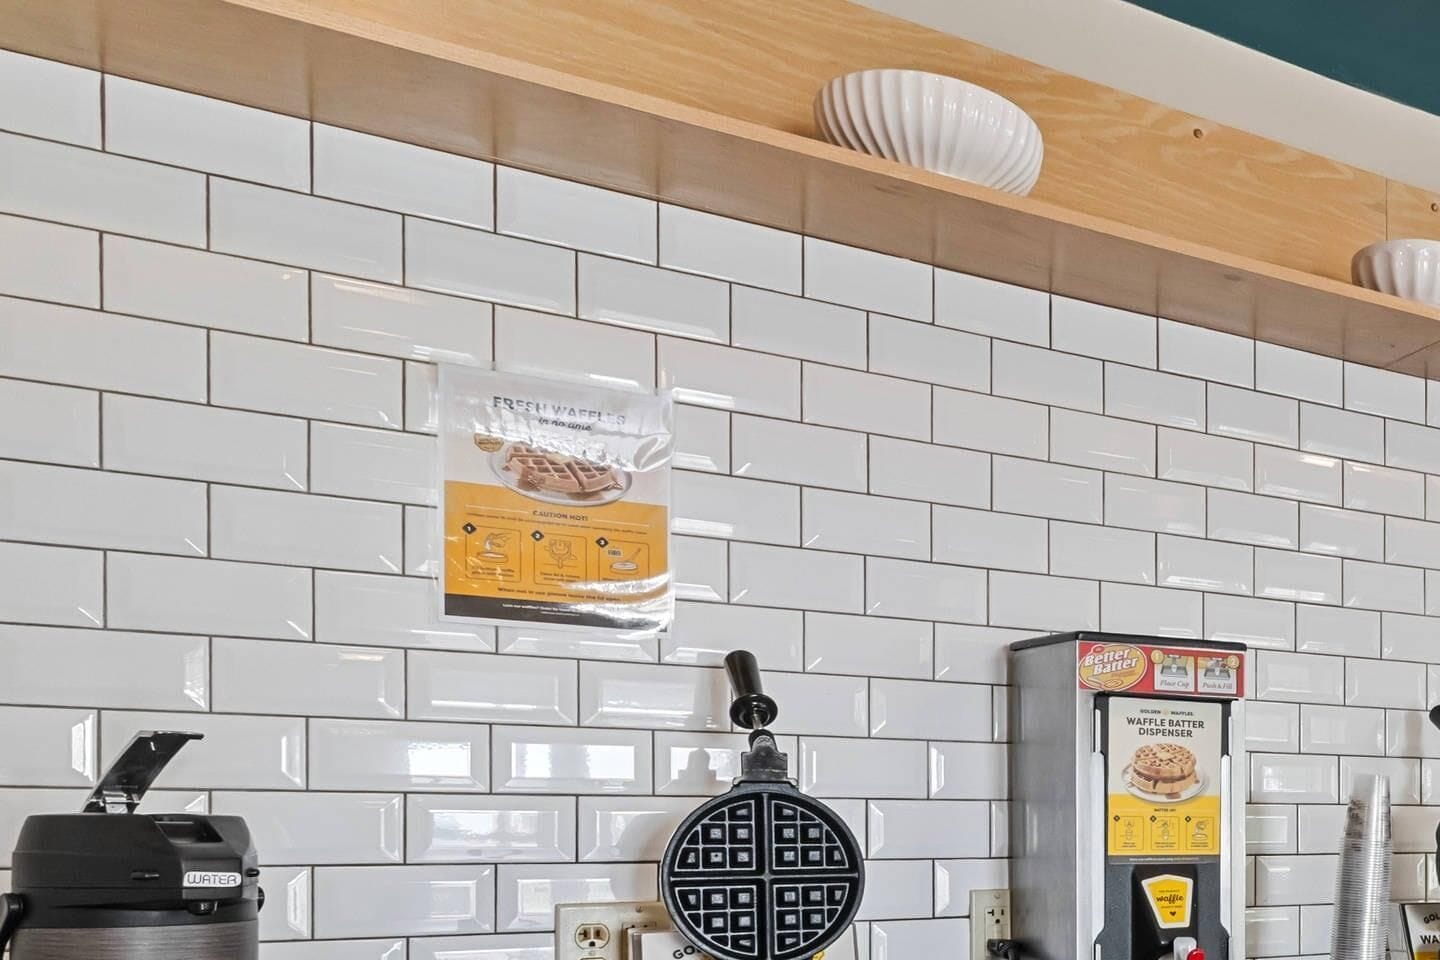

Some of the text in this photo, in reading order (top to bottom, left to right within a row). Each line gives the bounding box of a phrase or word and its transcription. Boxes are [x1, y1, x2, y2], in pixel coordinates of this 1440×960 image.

[493, 396, 625, 425] FRESH WAFFLES
[532, 510, 568, 519] CAUTION
[1084, 648, 1131, 667] Better
[1093, 657, 1138, 675] Batter
[1126, 717, 1205, 729] WAFFLE BATTER
[1138, 727, 1193, 737] DISPENSER
[186, 873, 237, 885] WATER
